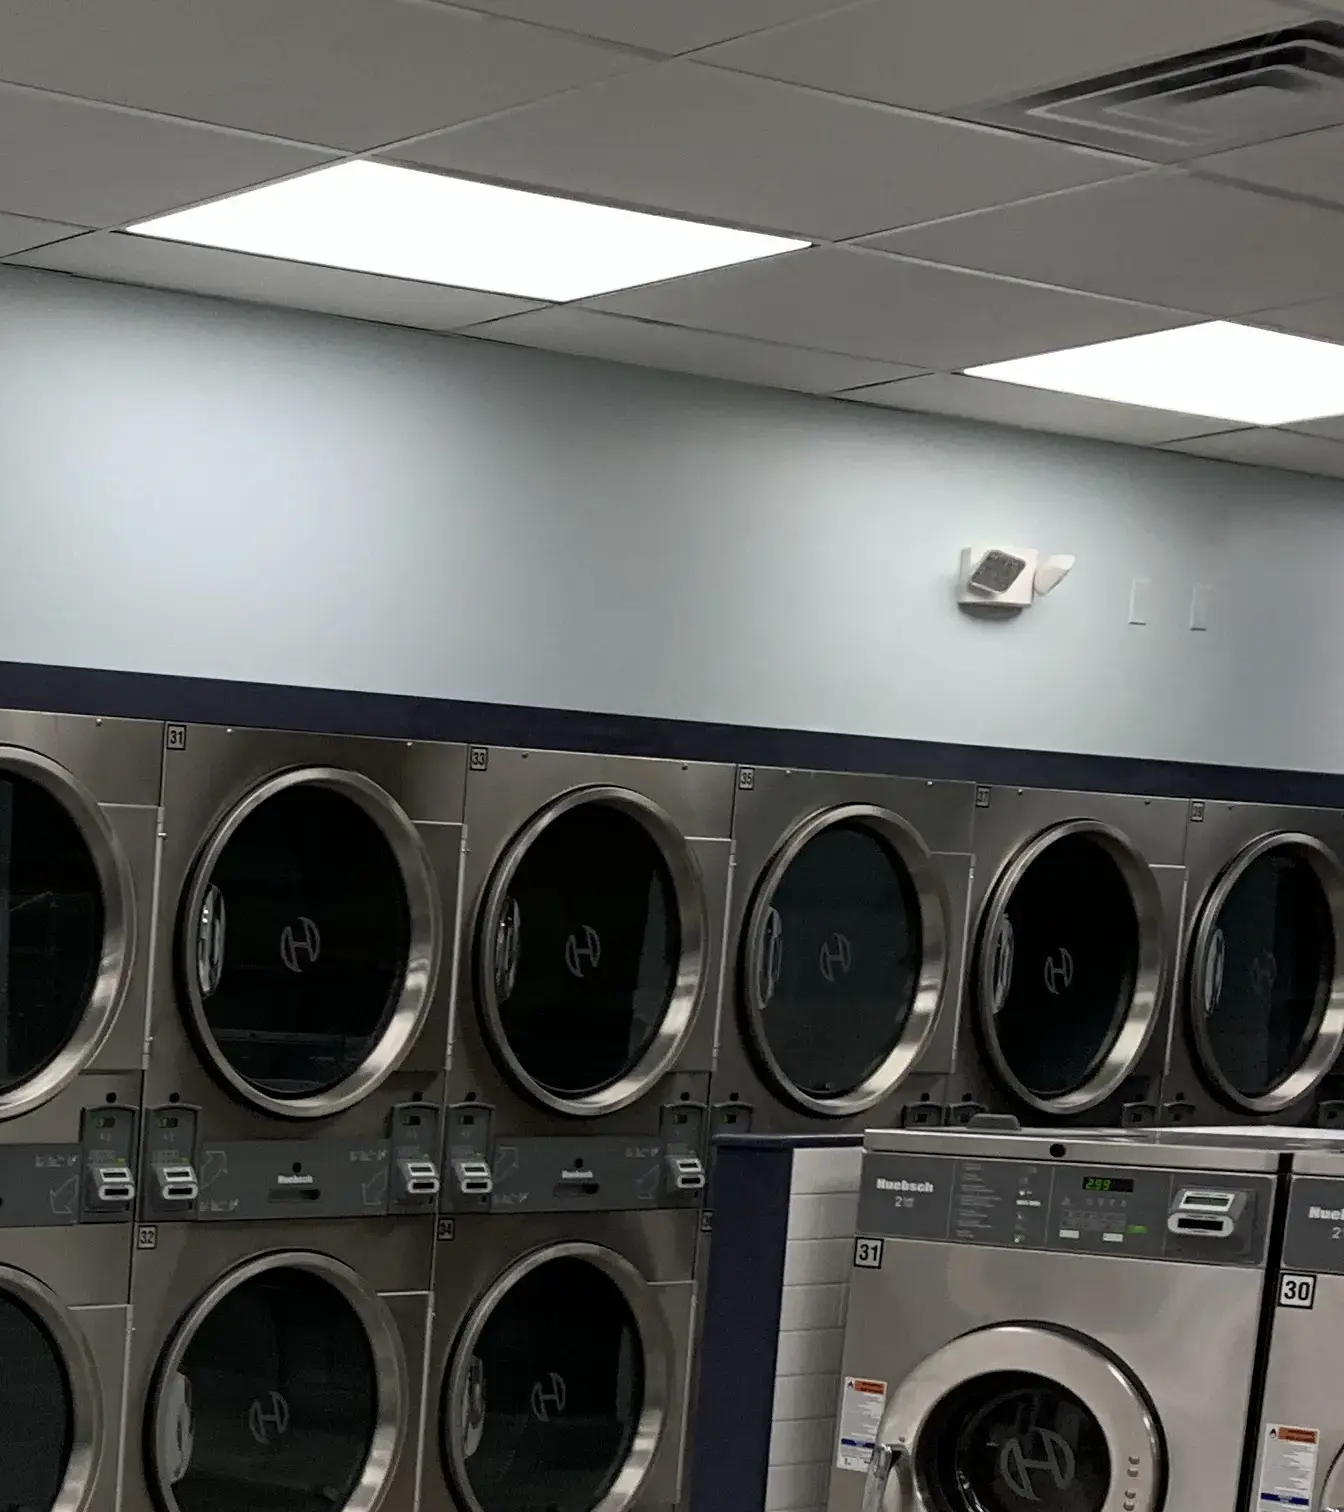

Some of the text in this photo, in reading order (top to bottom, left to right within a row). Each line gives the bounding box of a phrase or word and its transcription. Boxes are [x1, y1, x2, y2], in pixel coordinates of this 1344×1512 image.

[170, 730, 183, 747] 31
[876, 1178, 934, 1193] Huebsch
[859, 1243, 878, 1262] 31
[1284, 1280, 1310, 1301] 30
